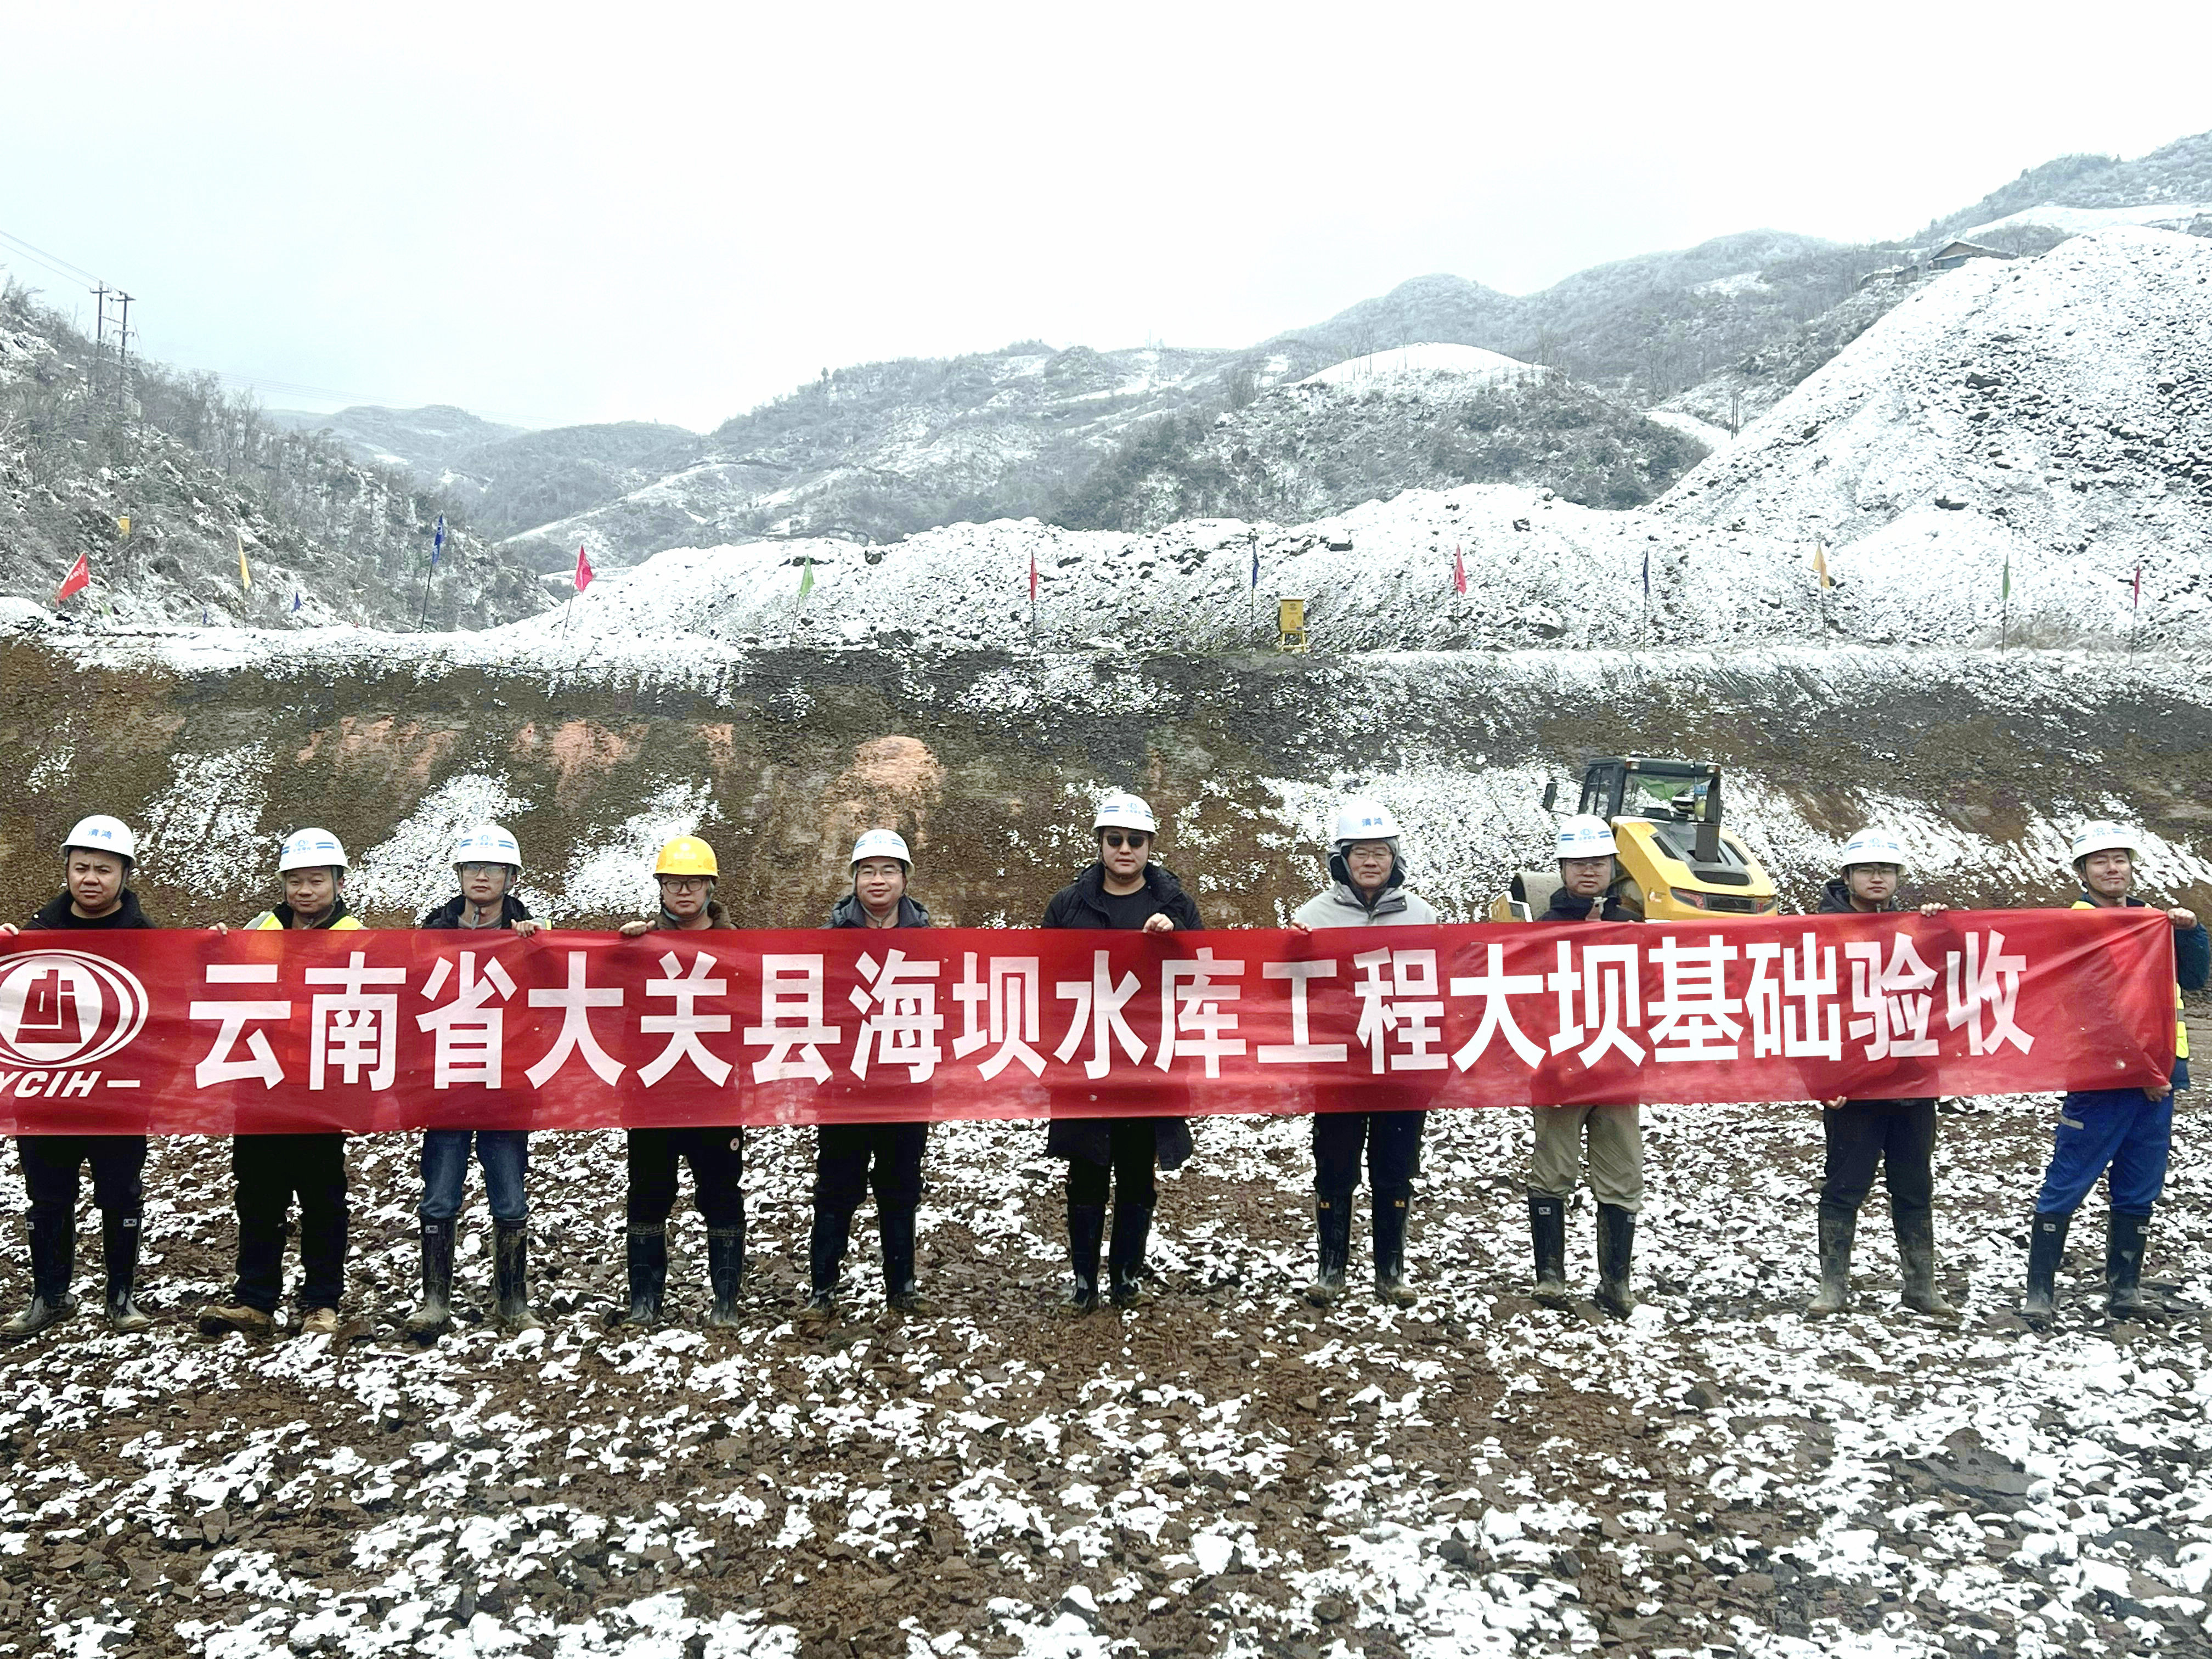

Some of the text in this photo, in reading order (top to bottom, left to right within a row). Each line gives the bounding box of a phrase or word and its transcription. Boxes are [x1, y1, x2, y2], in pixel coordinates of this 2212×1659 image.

[189, 930, 2034, 1091] 云南省大关县海坝水库工程大坝基础验收
